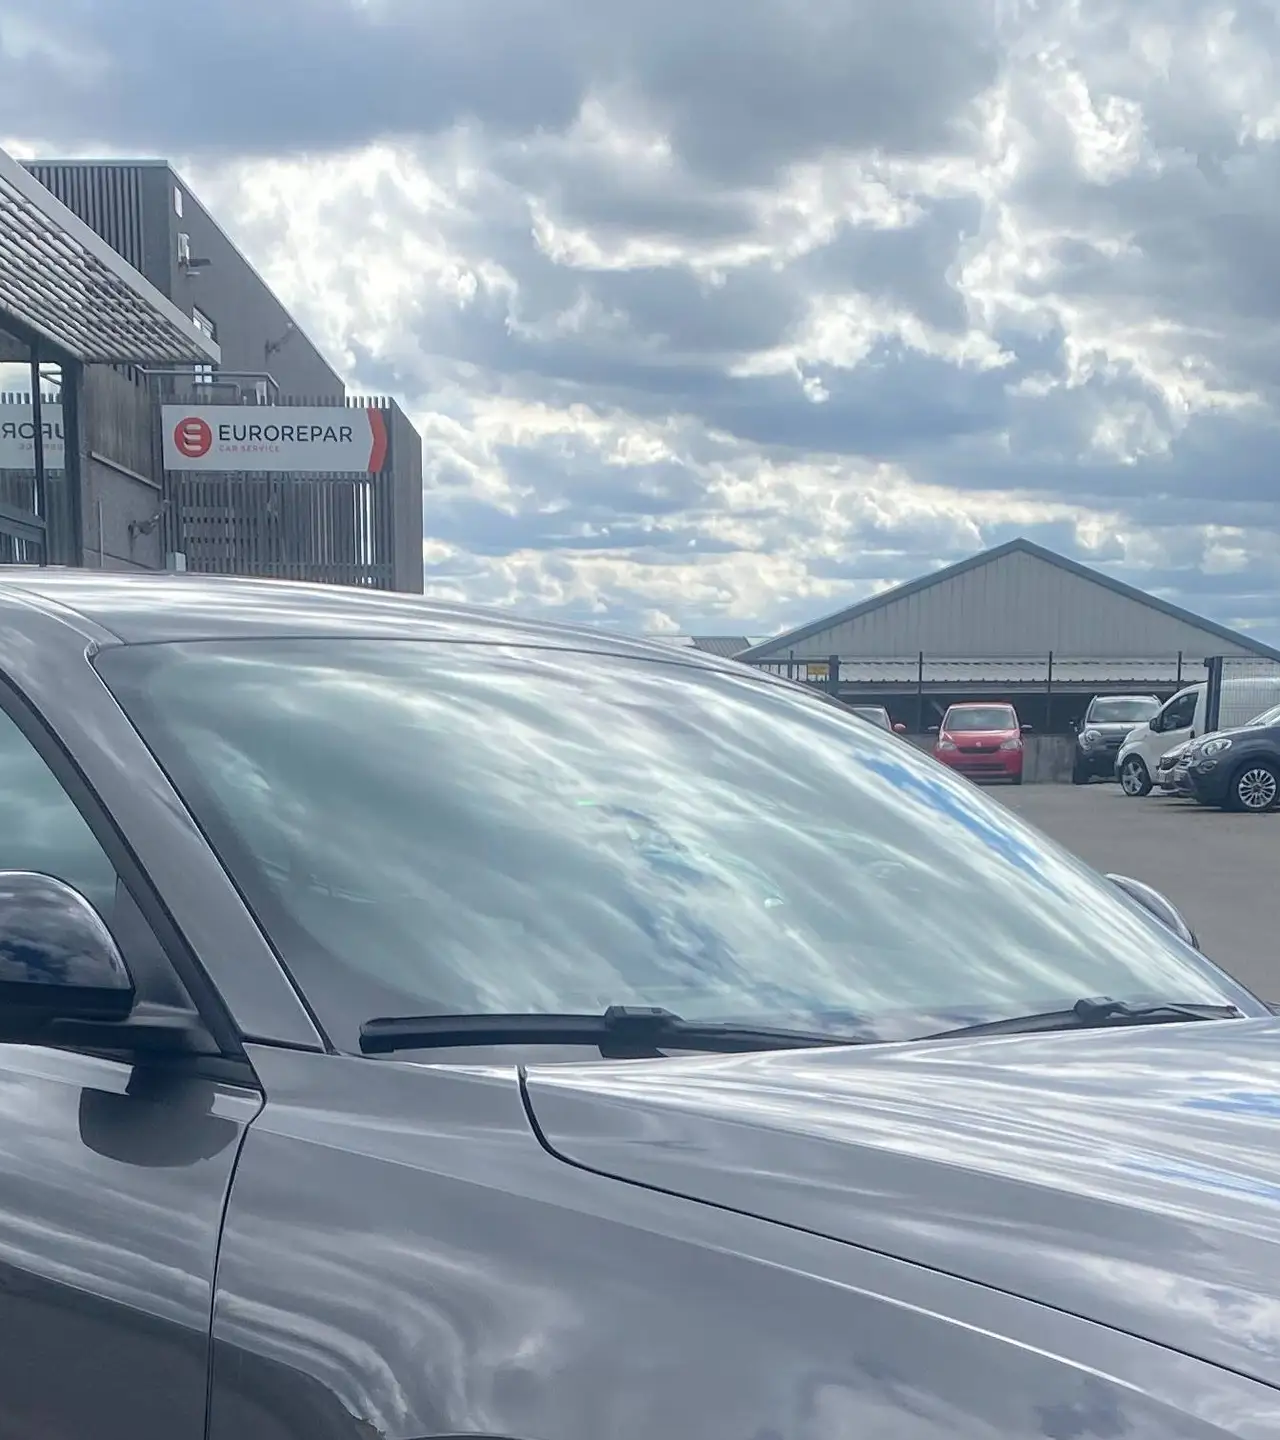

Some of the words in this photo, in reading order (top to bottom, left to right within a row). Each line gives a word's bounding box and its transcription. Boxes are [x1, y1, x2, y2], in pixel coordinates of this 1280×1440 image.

[219, 424, 353, 442] EUROREPAR
[219, 445, 238, 453] CAR
[241, 445, 280, 453] SERVICE
